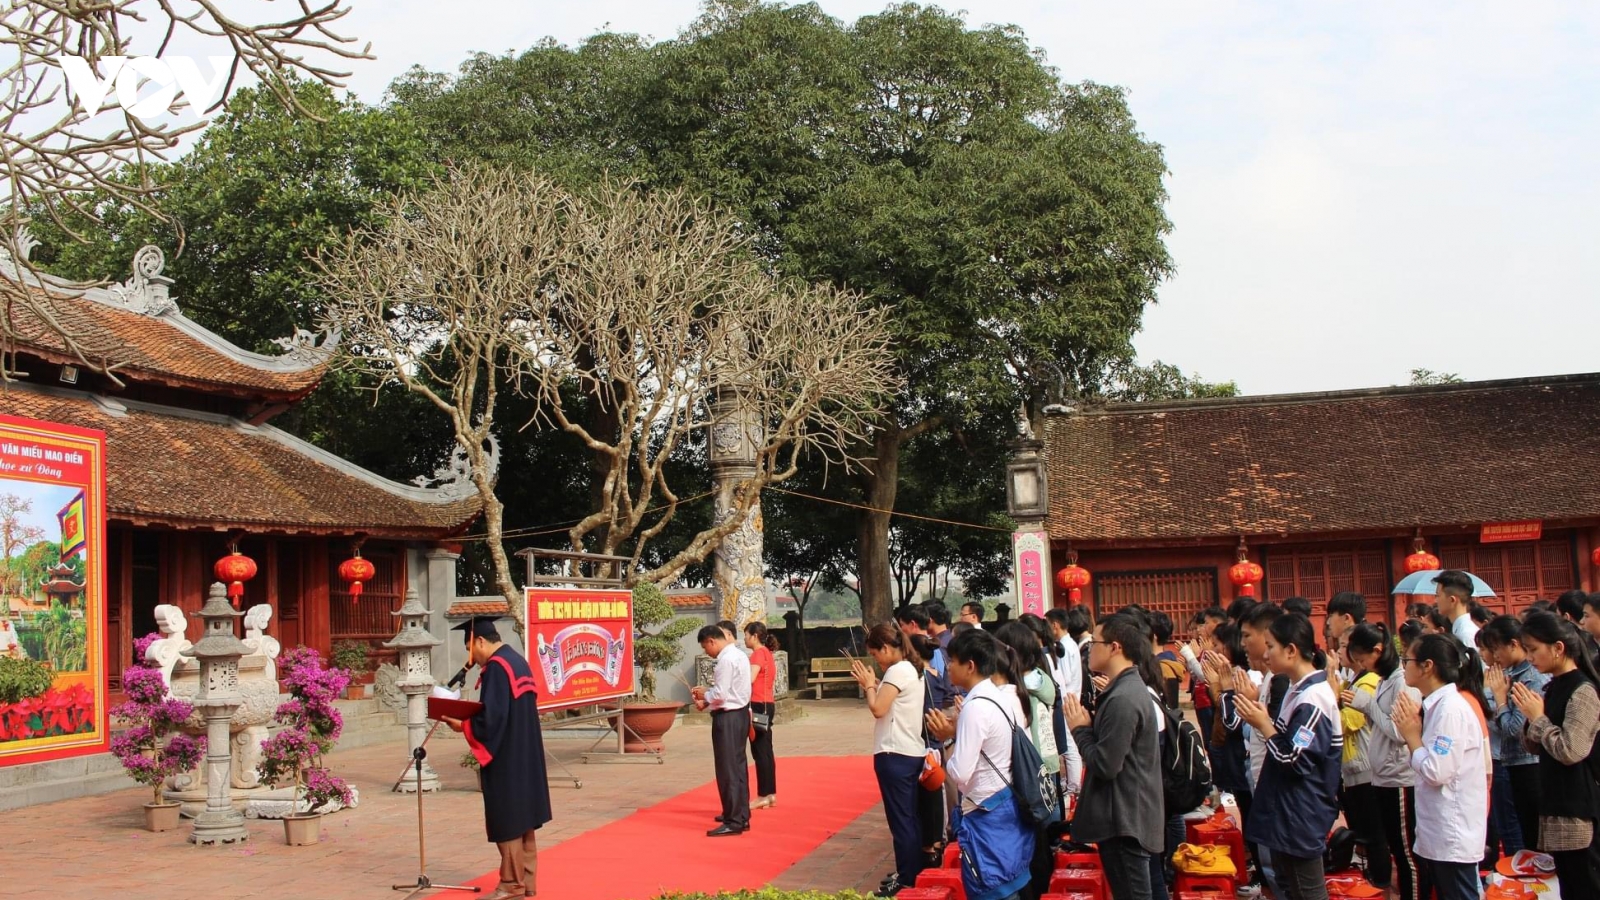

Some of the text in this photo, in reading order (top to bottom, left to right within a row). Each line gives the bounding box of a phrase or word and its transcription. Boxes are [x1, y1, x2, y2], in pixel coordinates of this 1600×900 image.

[2, 443, 19, 455] VĂN
[21, 445, 43, 459] MIẾU
[45, 450, 63, 462] MAO
